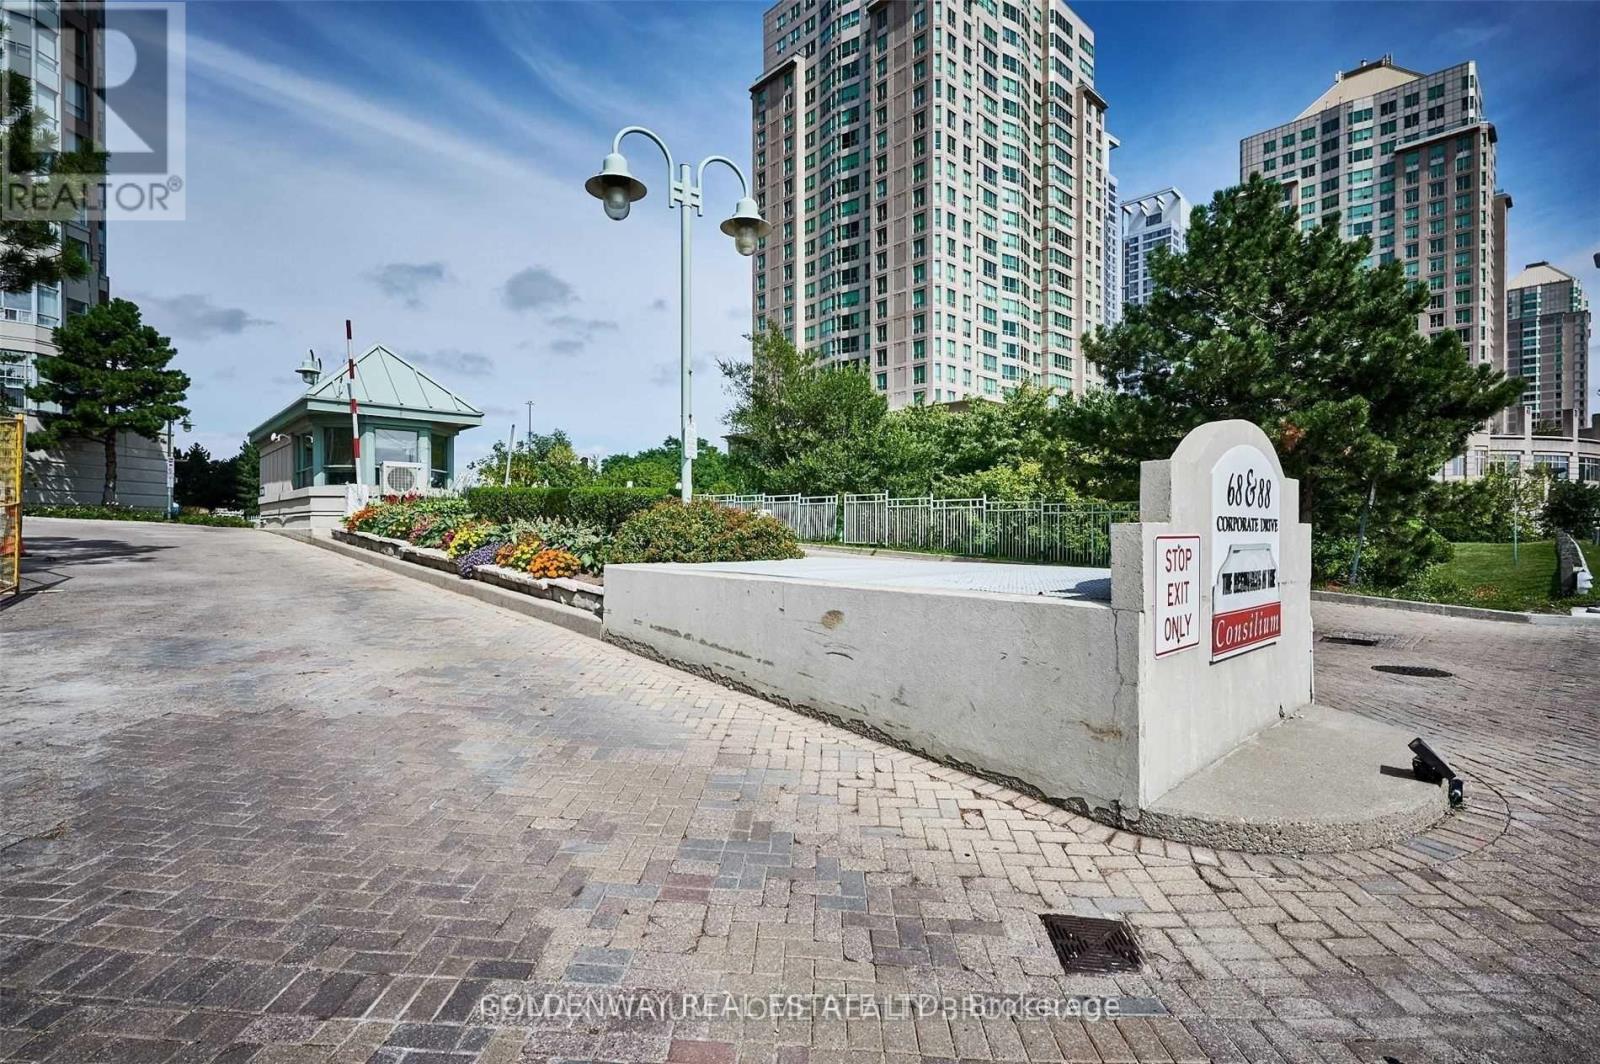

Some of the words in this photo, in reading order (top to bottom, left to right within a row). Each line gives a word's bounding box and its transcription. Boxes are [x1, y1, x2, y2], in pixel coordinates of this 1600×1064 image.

[1217, 515, 1258, 533] CORPORATE
[1260, 518, 1278, 533] DRIVE
[1165, 548, 1192, 573] STOP
[1167, 581, 1190, 606] EXIT
[1164, 613, 1192, 641] ONLY
[1216, 611, 1279, 648] Consilium
